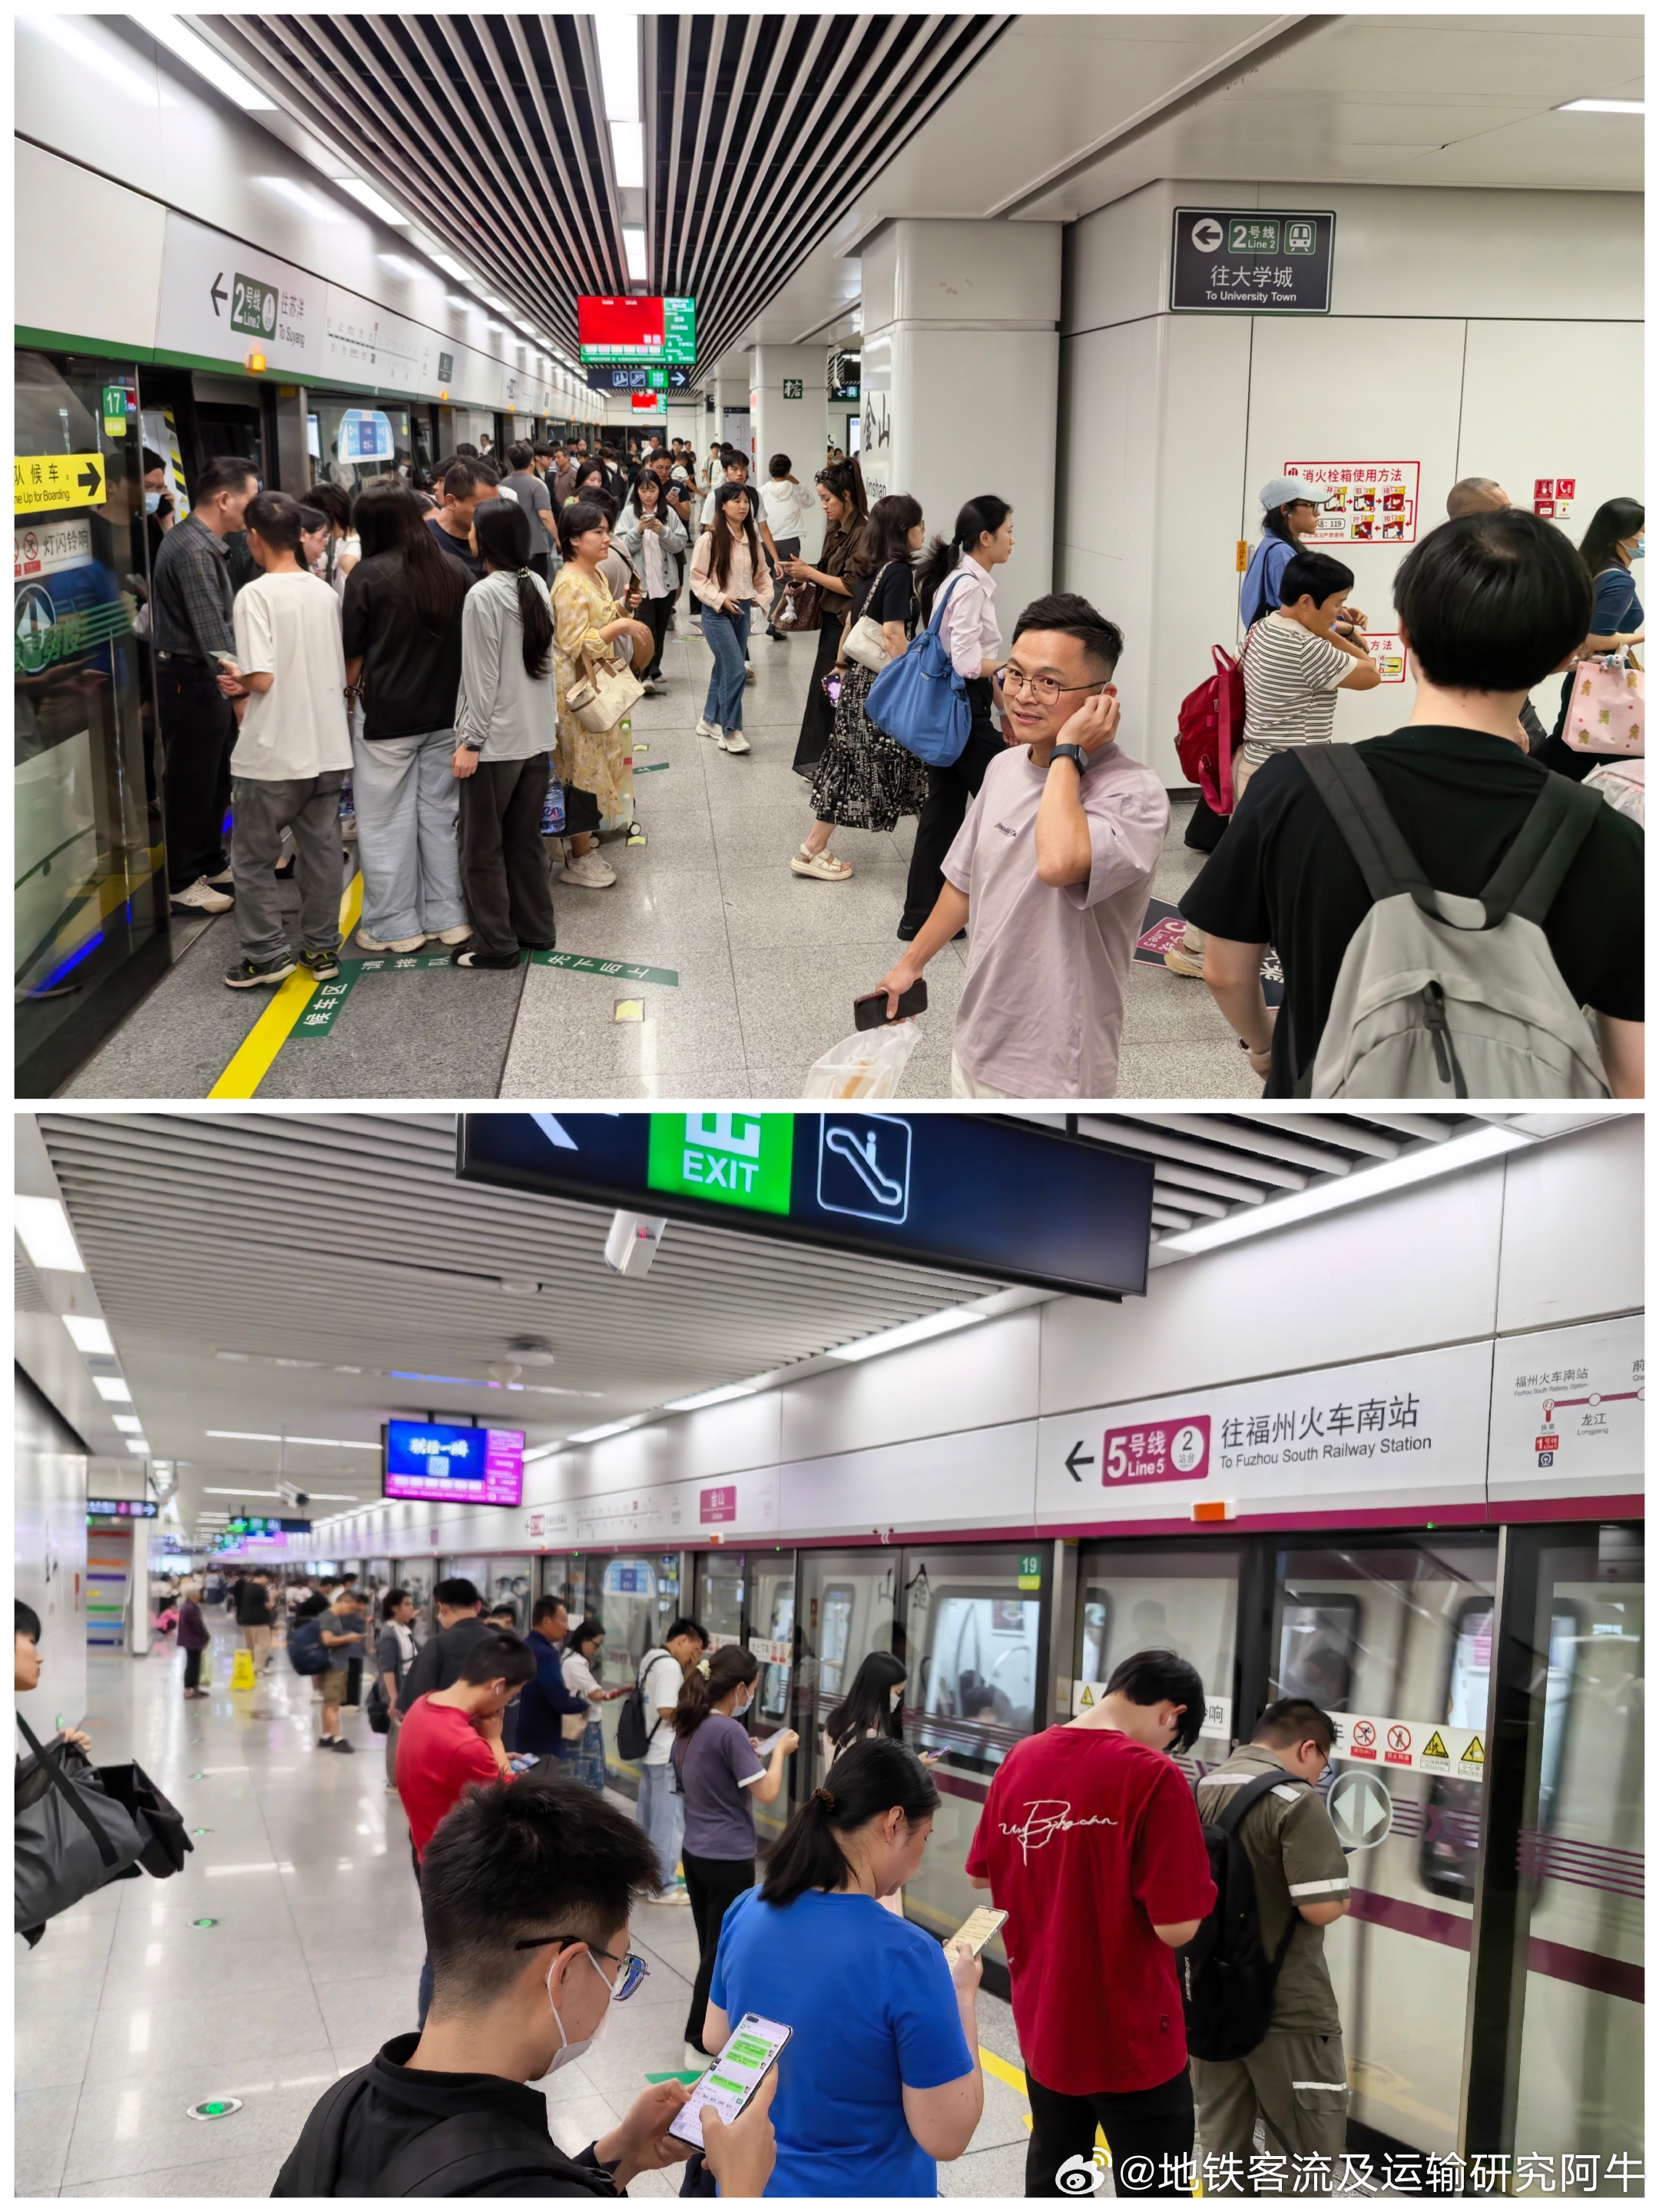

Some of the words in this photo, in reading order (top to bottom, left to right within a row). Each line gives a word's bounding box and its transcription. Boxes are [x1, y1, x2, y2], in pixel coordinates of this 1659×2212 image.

[1248, 240, 1267, 249] Line
[1270, 240, 1275, 249] 2
[1210, 265, 1293, 288] 往大学城
[1206, 290, 1217, 300] To
[1220, 291, 1268, 303] University
[1271, 292, 1296, 302] Town
[279, 323, 285, 339] To
[286, 326, 305, 349] Suyang
[106, 392, 121, 414] 17
[863, 391, 891, 452] 金山
[866, 476, 886, 498] Jinshan
[1303, 469, 1402, 483] 消火栓箱使用方法
[24, 492, 33, 505] Up
[34, 490, 42, 502] for
[42, 529, 89, 556] 灯闪铃响
[1370, 640, 1392, 651] 方法
[1151, 929, 1172, 944] Line
[361, 956, 451, 970] 请排队
[548, 955, 650, 979] 先下后上
[303, 984, 348, 1026] 候车区
[684, 1149, 760, 1193] EXIT
[1515, 1366, 1588, 1388] 福州火车南站
[1221, 1392, 1419, 1449] 往福州火车南站
[1581, 1412, 1607, 1426] 龙江
[1182, 1430, 1193, 1451] 2
[1220, 1455, 1232, 1469] To
[1236, 1452, 1278, 1467] Fuzhou
[1283, 1446, 1318, 1463] South
[1323, 1442, 1376, 1459] Railway
[1380, 1435, 1432, 1453] Station
[1128, 1462, 1155, 1477] Line
[1156, 1458, 1164, 1474] 5
[1022, 1557, 1037, 1574] 19
